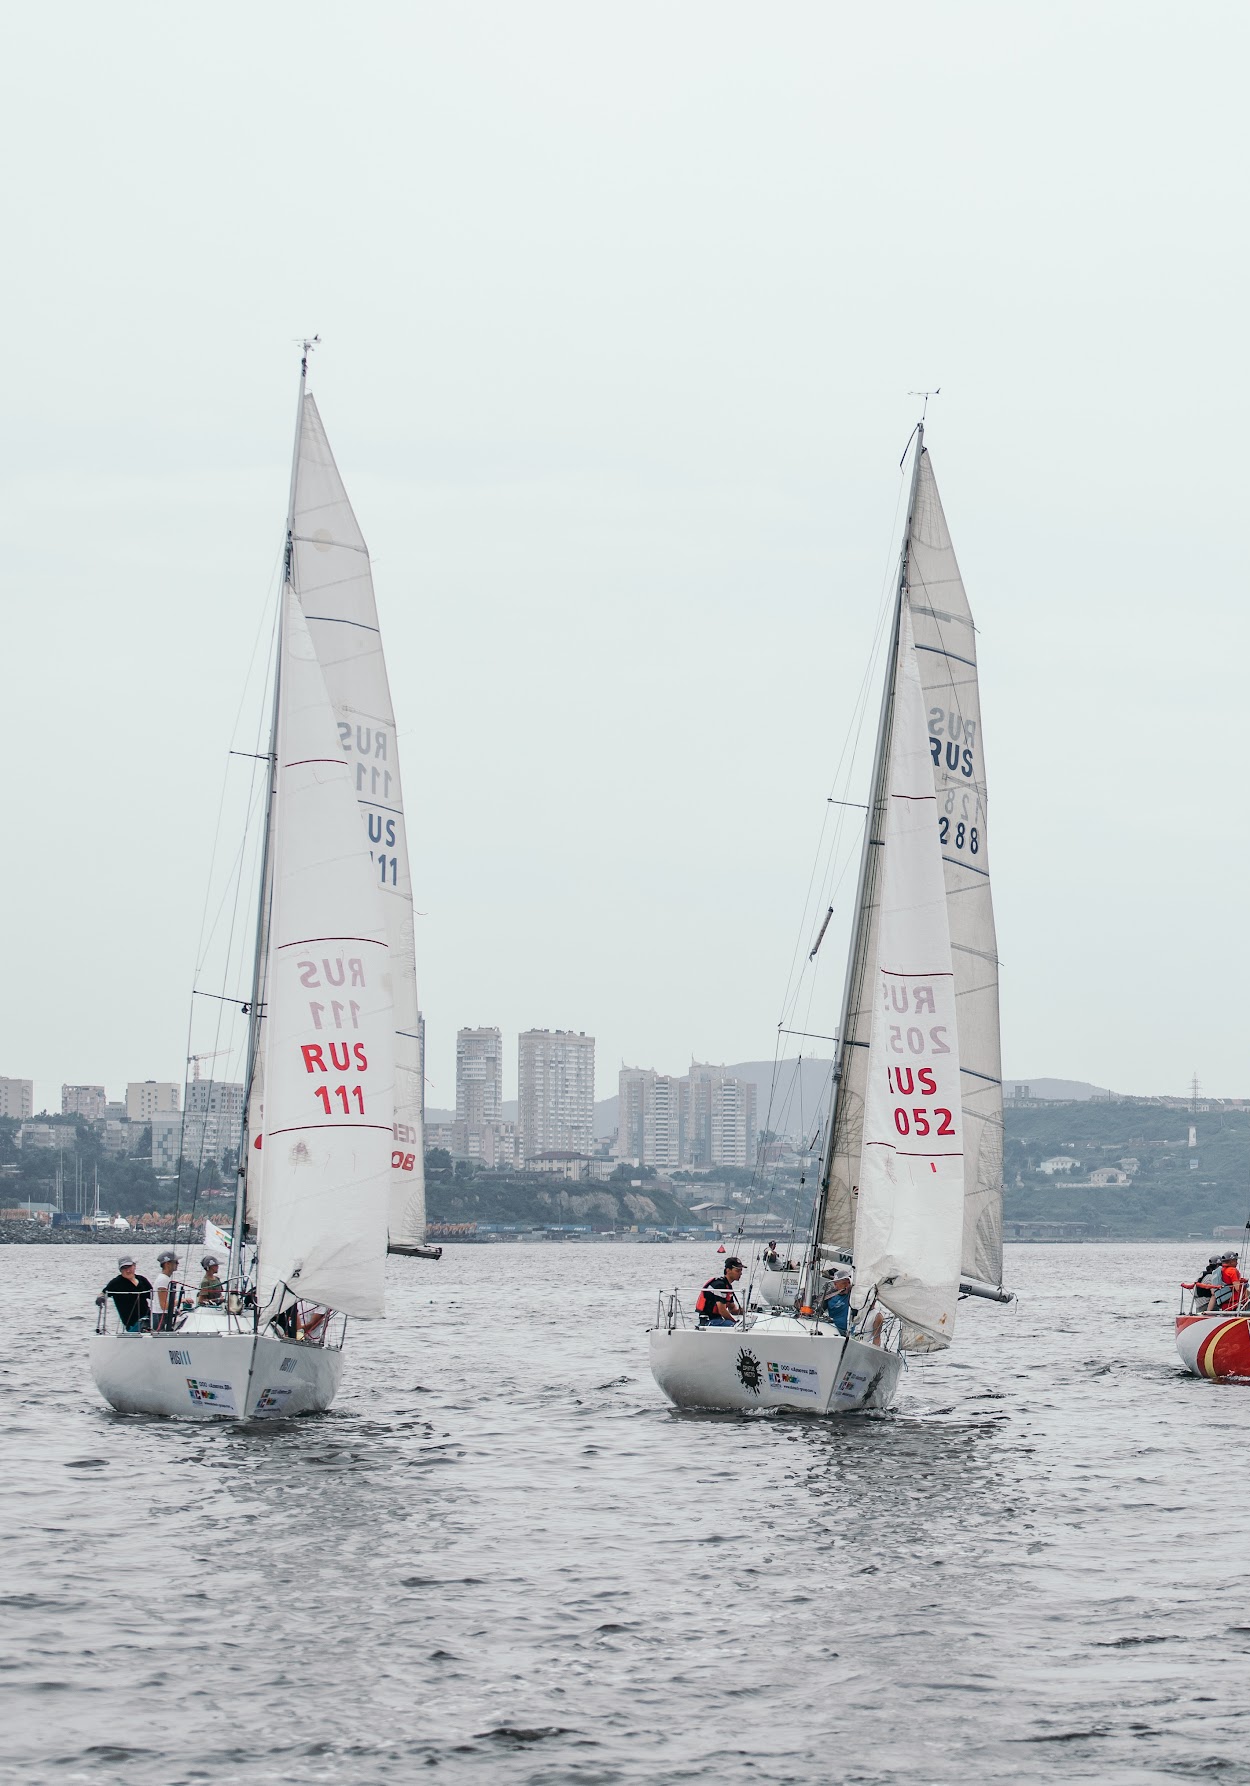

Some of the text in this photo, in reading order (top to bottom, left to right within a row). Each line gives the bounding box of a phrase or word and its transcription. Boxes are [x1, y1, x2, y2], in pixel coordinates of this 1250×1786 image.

[929, 736, 973, 778] RUS
[366, 813, 396, 848] US
[369, 850, 398, 886] 11
[300, 1041, 368, 1073] RUS
[887, 1066, 938, 1095] US
[314, 1085, 365, 1115] 111
